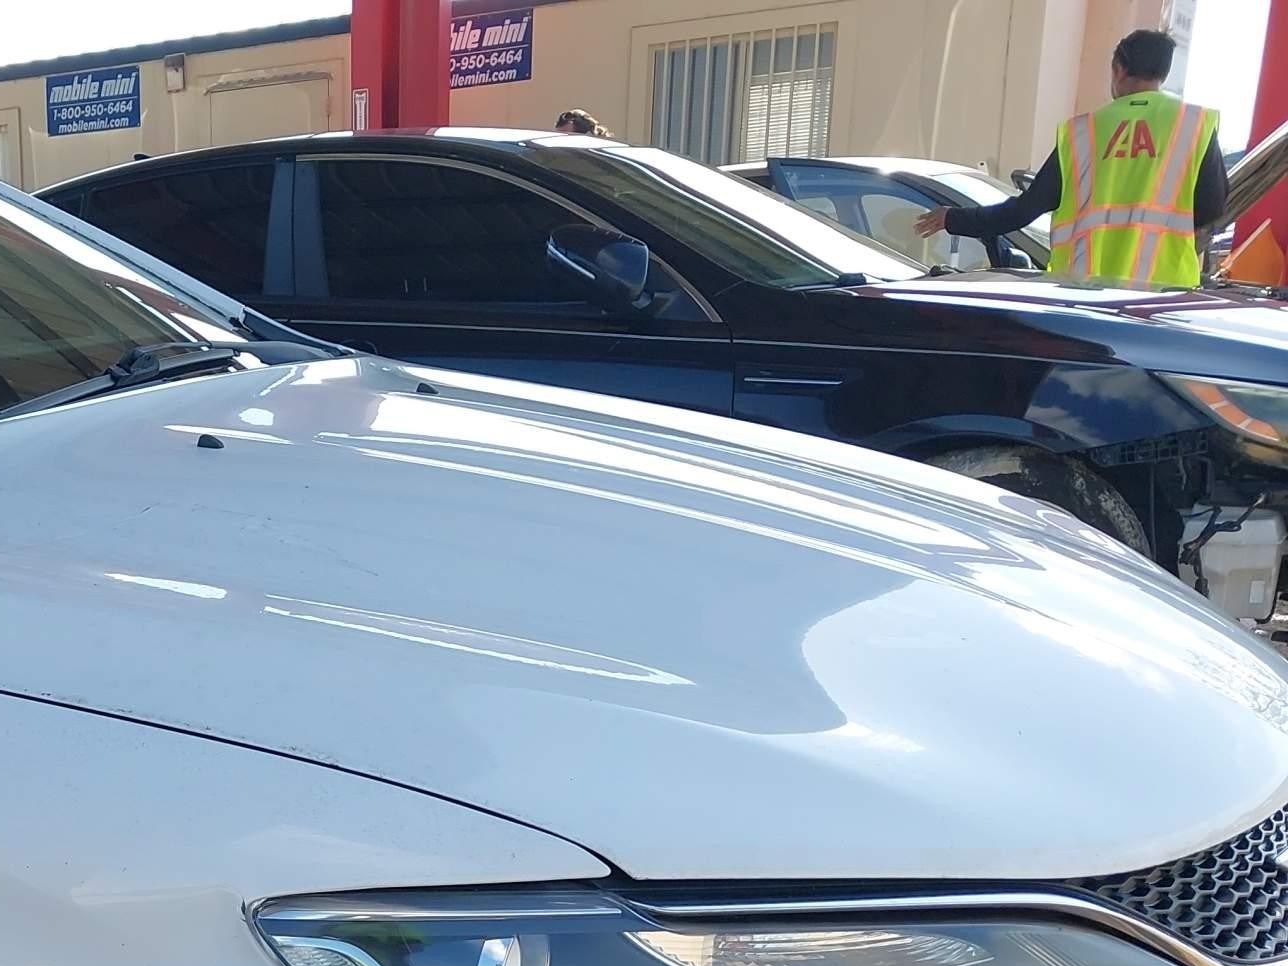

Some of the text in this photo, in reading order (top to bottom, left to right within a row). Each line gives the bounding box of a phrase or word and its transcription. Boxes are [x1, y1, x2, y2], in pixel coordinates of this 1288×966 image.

[450, 16, 529, 51] bile mini
[450, 49, 523, 72] 0-950-6464
[49, 72, 137, 103] mobile mini
[450, 68, 517, 87] ilemini.com
[53, 100, 133, 120] 1-800-950-6464
[58, 117, 129, 133] mobilemini.com
